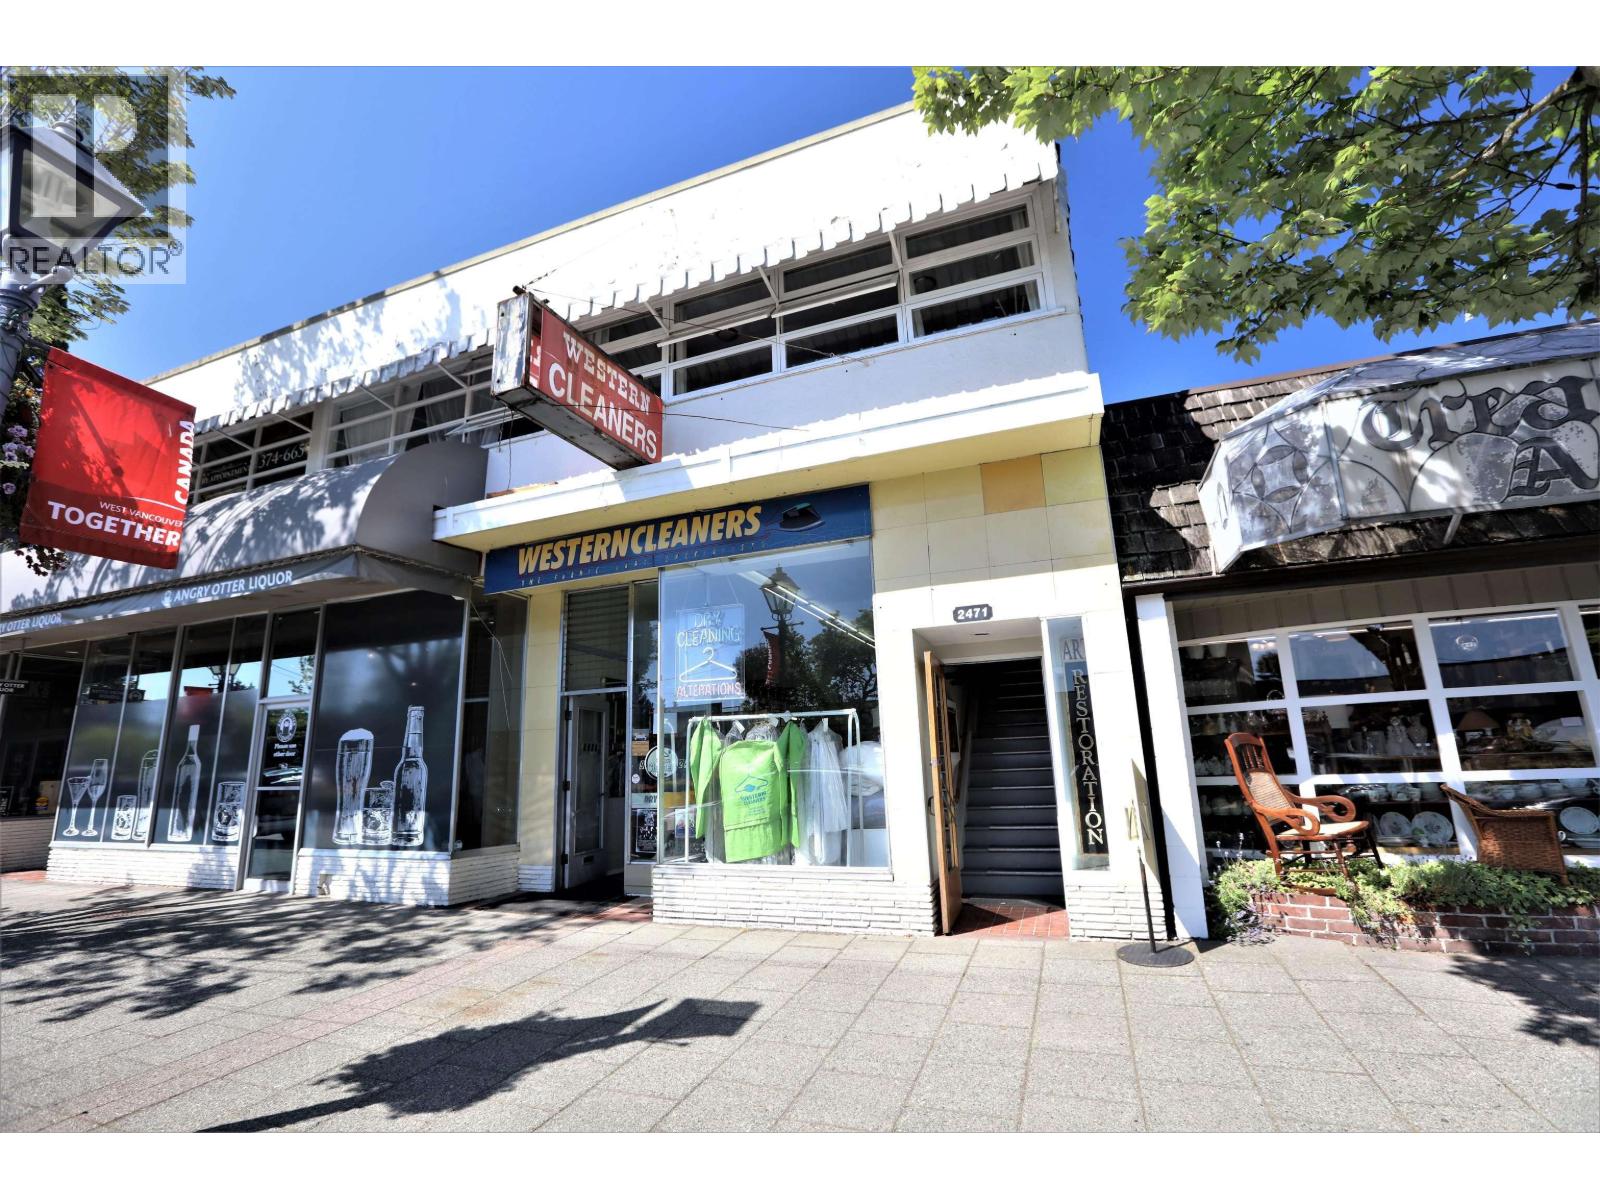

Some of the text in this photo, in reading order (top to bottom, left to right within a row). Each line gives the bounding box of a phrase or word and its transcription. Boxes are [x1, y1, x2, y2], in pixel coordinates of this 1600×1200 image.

[563, 331, 651, 416] WESTERN
[549, 362, 657, 459] CLEANERS
[174, 420, 195, 506] CANADA
[100, 501, 127, 514] WEST
[48, 501, 181, 547] TOGETHER
[174, 570, 293, 602] ANGRY OTTER LIQUOR
[6, 618, 31, 632] OTTER
[31, 612, 62, 629] LIQUOR
[957, 606, 988, 620] 2471
[677, 626, 741, 648] CLEANING
[1063, 638, 1084, 661] AR
[676, 682, 742, 698] ALTERATIONS
[1072, 669, 1104, 846] RESTORATION
